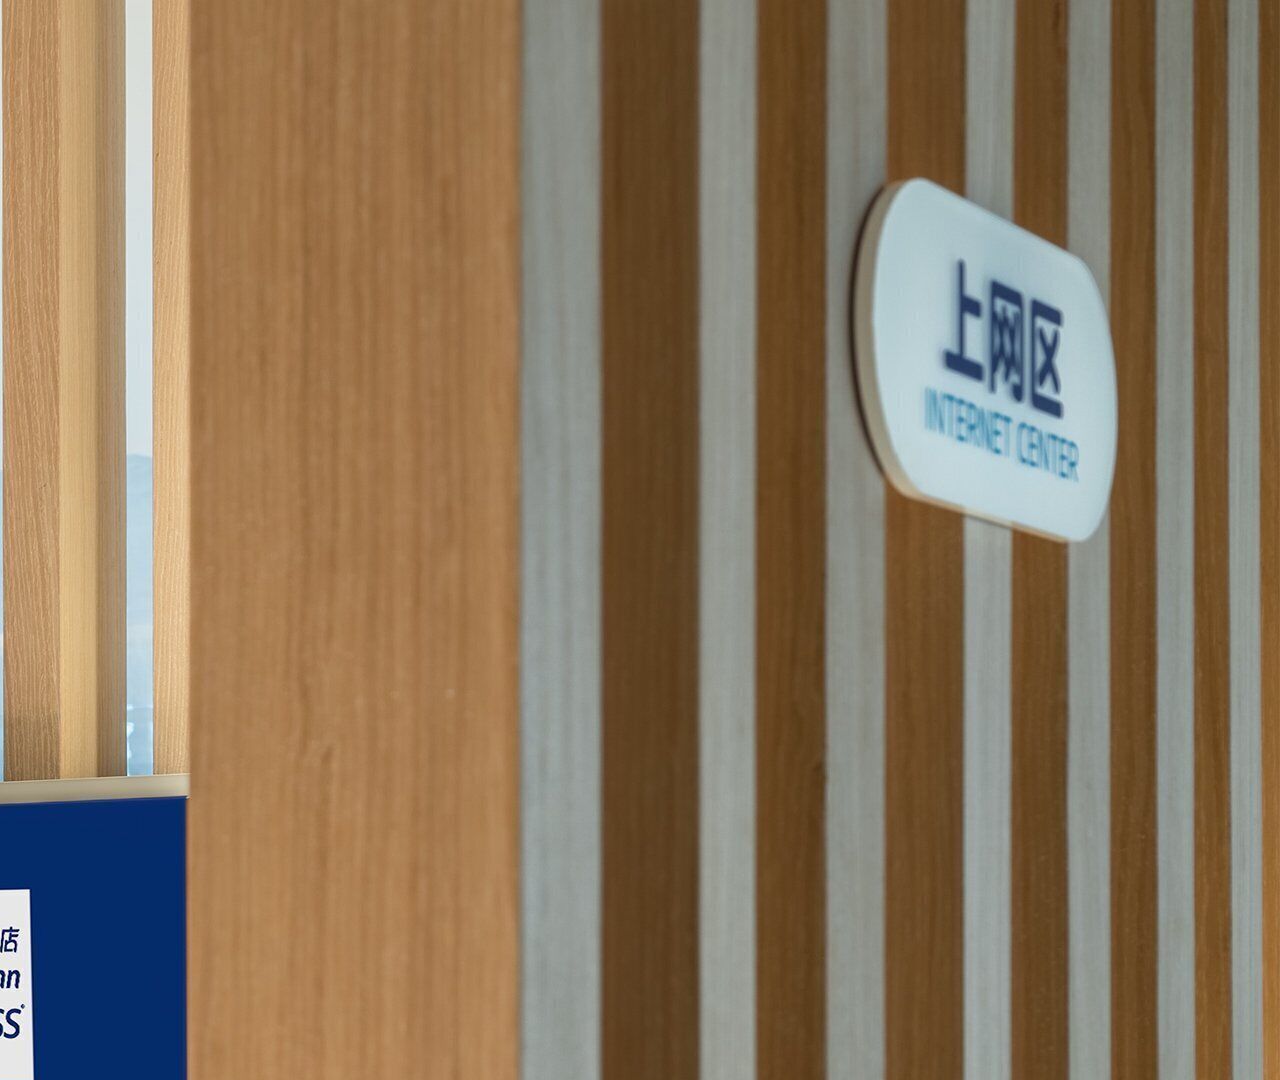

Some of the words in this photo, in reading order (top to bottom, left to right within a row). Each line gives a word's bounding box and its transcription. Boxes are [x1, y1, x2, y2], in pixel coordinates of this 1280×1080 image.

[944, 258, 1064, 420] 上网区
[923, 386, 1012, 457] INTERNET
[1016, 421, 1080, 483] CENTER
